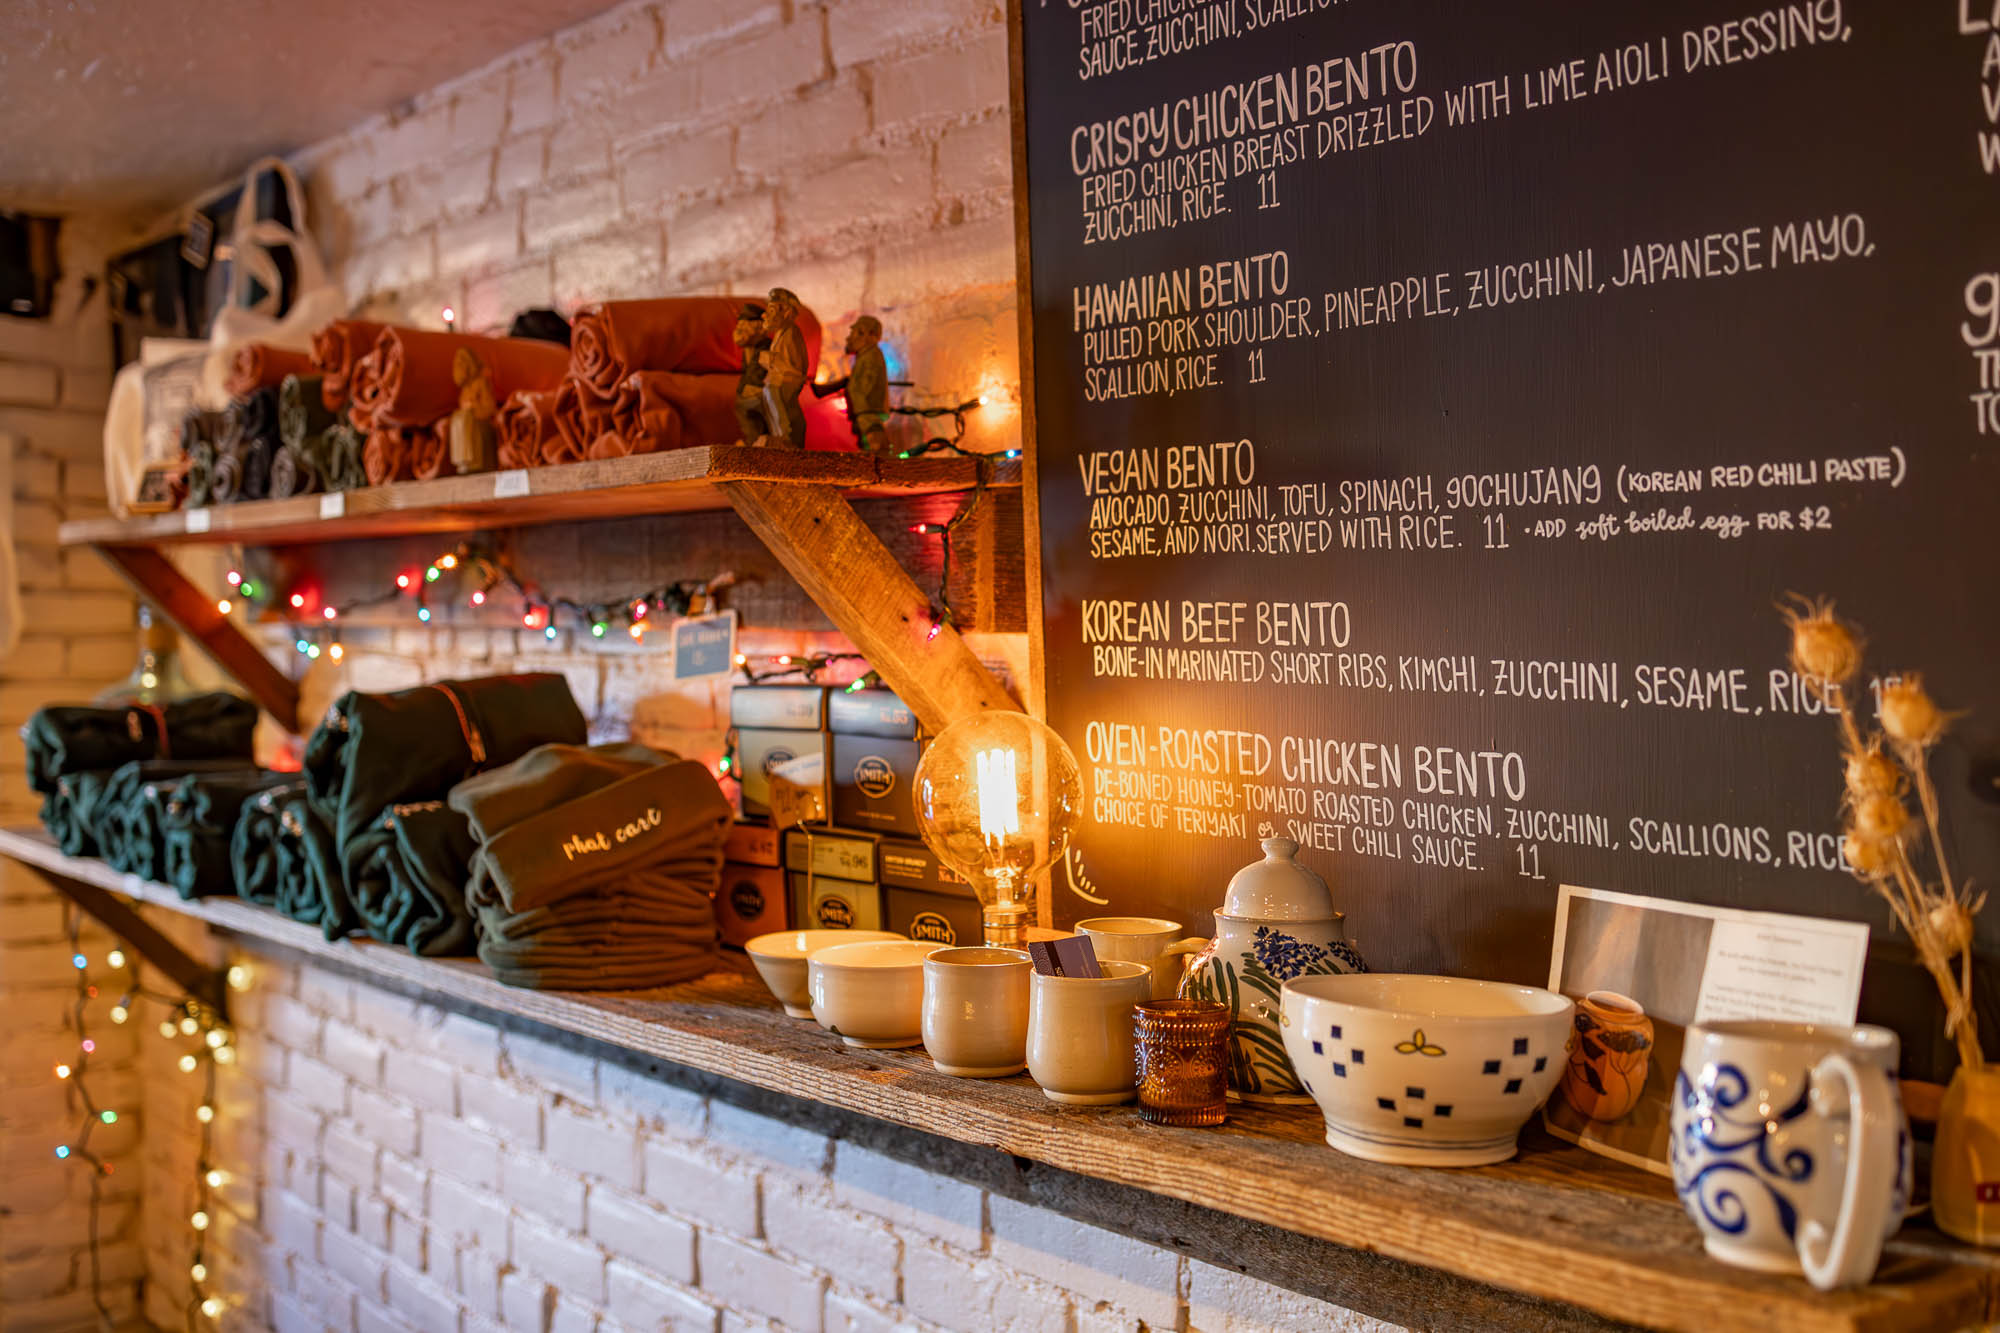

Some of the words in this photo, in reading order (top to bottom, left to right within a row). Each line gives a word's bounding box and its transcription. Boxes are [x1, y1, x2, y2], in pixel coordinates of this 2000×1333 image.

[1079, 29, 1143, 80] SAUCE,
[1144, 0, 1241, 60] ZUCCHINI,
[1081, 0, 1131, 45] FRIED
[1071, 103, 1169, 176] CRISPY
[1174, 67, 1299, 150] CHICKEN
[1306, 41, 1417, 116] BENTO
[1082, 172, 1136, 213] FRIED
[1141, 144, 1227, 198] CHICKEN
[1234, 124, 1309, 177] BREAST
[1318, 97, 1433, 159] DRIZZLED
[1445, 75, 1511, 127] WITH
[1525, 59, 1587, 109] LIME
[1594, 37, 1668, 94] AIOLI
[1083, 194, 1177, 245] ZUCCHINI,
[1182, 182, 1232, 221] RICE.
[1257, 170, 1281, 211] 11
[1074, 267, 1190, 332] HAWAIIAN
[1200, 251, 1289, 310] BENTO
[1084, 322, 1142, 366] PULLED
[1149, 316, 1201, 353] PORK
[1204, 298, 1319, 348] SHOULDER,
[1325, 273, 1460, 332] PINEAPPLE,
[1465, 248, 1605, 309] ZUCCHINI,
[1612, 228, 1762, 287] JAPANESE
[1771, 214, 1875, 268] MAYO,
[1084, 357, 1175, 402] SCALLION,
[1176, 354, 1224, 389] RICE.
[1248, 349, 1266, 383] 11
[1079, 448, 1159, 496] VEGAN
[1168, 439, 1255, 490] BENTO
[1090, 493, 1175, 530] AVOCADO,
[1179, 486, 1278, 525] ZUCCHINI,
[1279, 482, 1334, 517] TOFU,
[1340, 475, 1440, 514] SPINACH,
[1447, 464, 1601, 508] GOCHUJANG
[1617, 464, 1702, 503] (KOREAN
[1711, 466, 1753, 488] RED
[1758, 460, 1817, 487] CHILI
[1825, 446, 1907, 488] PASTE)
[1091, 526, 1162, 559] SESAME,
[1165, 524, 1199, 555] AND
[1256, 519, 1332, 555] SERVED
[1340, 516, 1391, 550] WITH
[1400, 514, 1462, 551] RICE.
[1483, 513, 1509, 549] 11
[1575, 513, 1620, 541] soft
[1624, 506, 1695, 533] boiled
[1700, 513, 1749, 539] egg
[1757, 510, 1794, 530] FOR
[1799, 506, 1832, 531] $2
[1082, 600, 1170, 643] KOREAN
[1182, 601, 1248, 643] BEEF
[1256, 601, 1350, 648] BENTO
[1094, 646, 1163, 680] BONE-IN
[1167, 649, 1265, 683] MARINATED
[1271, 651, 1334, 686] SHORT
[1339, 653, 1393, 692] RIBS,
[1400, 655, 1485, 697] KIMCHI,
[1491, 659, 1628, 709] ZUCCHINI,
[1635, 664, 1762, 716] SESAME,
[1086, 721, 1272, 776] OVEN-ROASTED
[1281, 736, 1402, 789] CHICKEN
[1415, 746, 1526, 801] BENTO
[1094, 767, 1172, 802] DE-BONED
[1178, 776, 1307, 815] HONEY-TOMATO
[1313, 790, 1395, 827] ROASTED
[1403, 799, 1502, 839] CHICKEN,
[1504, 808, 1619, 851] ZUCCHINI,
[1630, 817, 1781, 868] SCALLIONS,
[1094, 797, 1146, 828] CHOICE
[1151, 803, 1169, 829] OF
[1174, 807, 1247, 839] TERIYAKI
[1287, 819, 1347, 852] SWEET
[1353, 827, 1402, 859] CHILI
[1412, 834, 1484, 871] SAUCE.
[1516, 843, 1546, 880] 11
[916, 924, 951, 943] SMITH
